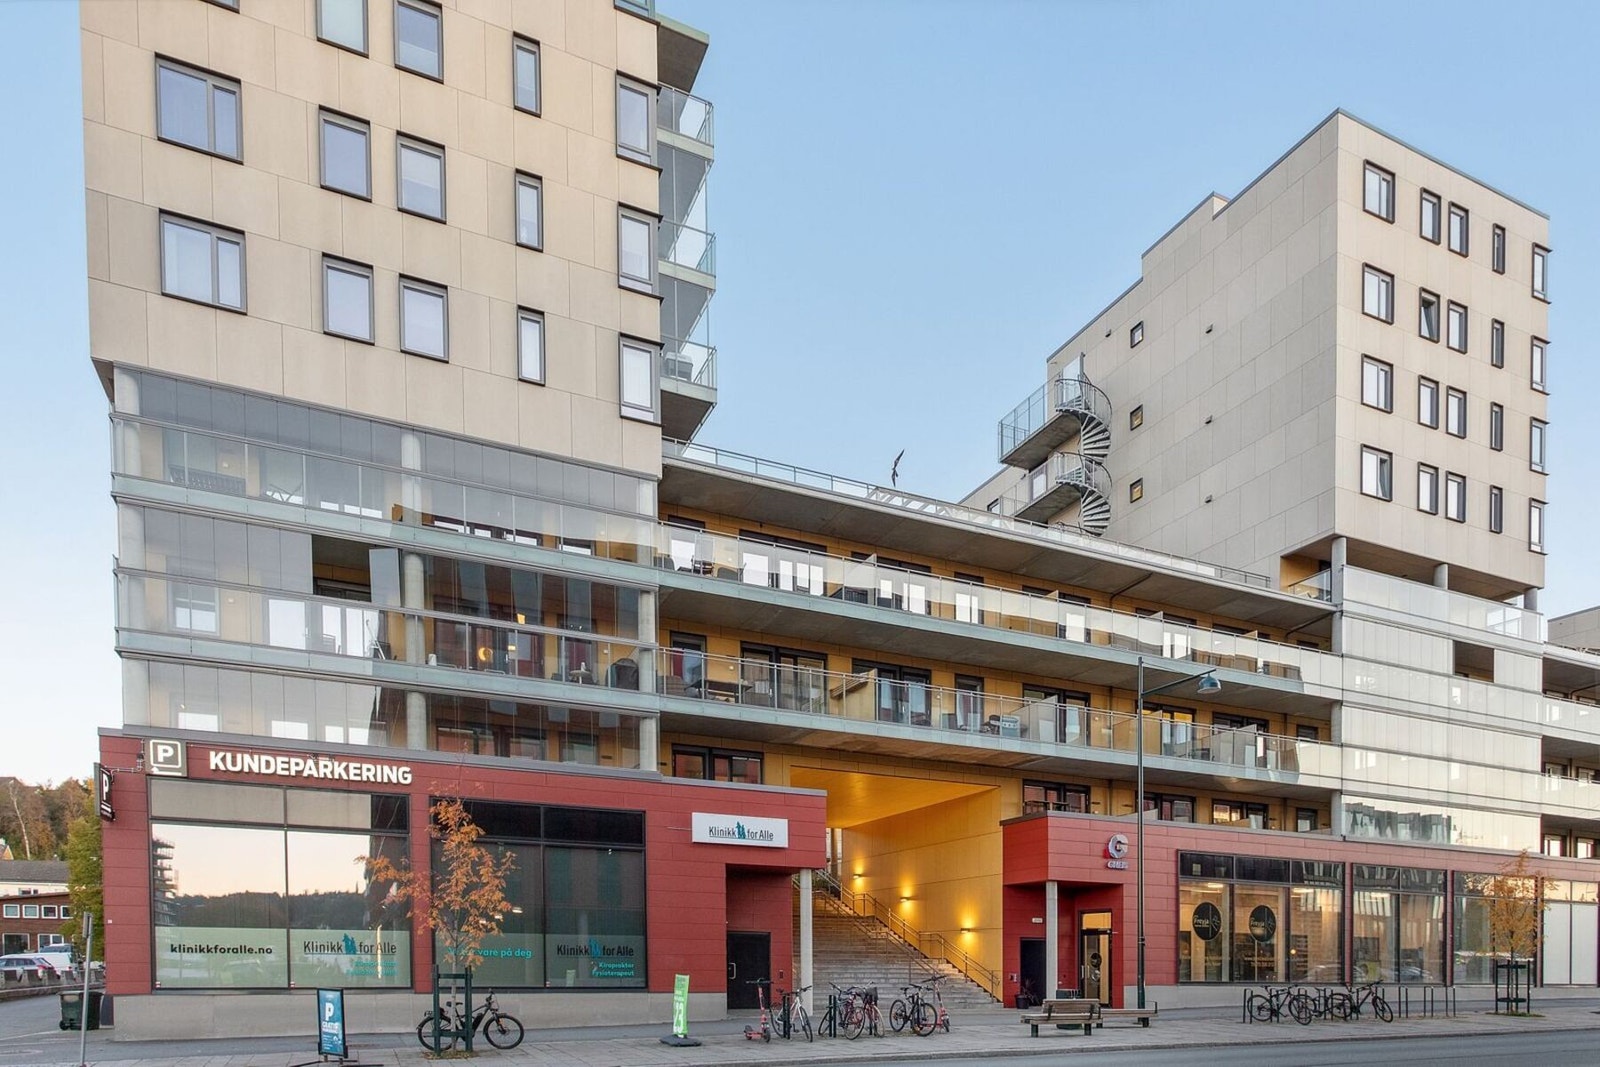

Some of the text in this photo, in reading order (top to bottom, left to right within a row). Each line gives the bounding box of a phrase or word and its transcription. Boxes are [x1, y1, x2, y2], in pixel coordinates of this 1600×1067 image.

[157, 744, 174, 762] P
[209, 751, 412, 785] KUNDEPARKERING
[103, 773, 109, 800] P
[708, 826, 774, 840] Klinikk for Alle
[170, 944, 273, 955] klinikkforalle.no
[303, 941, 343, 953] Klinikk
[359, 942, 374, 954] for
[478, 949, 498, 957] vare
[501, 948, 512, 958] på
[514, 949, 532, 958] deg
[557, 945, 634, 956] Klinikk for Alle
[325, 1002, 335, 1021] P
